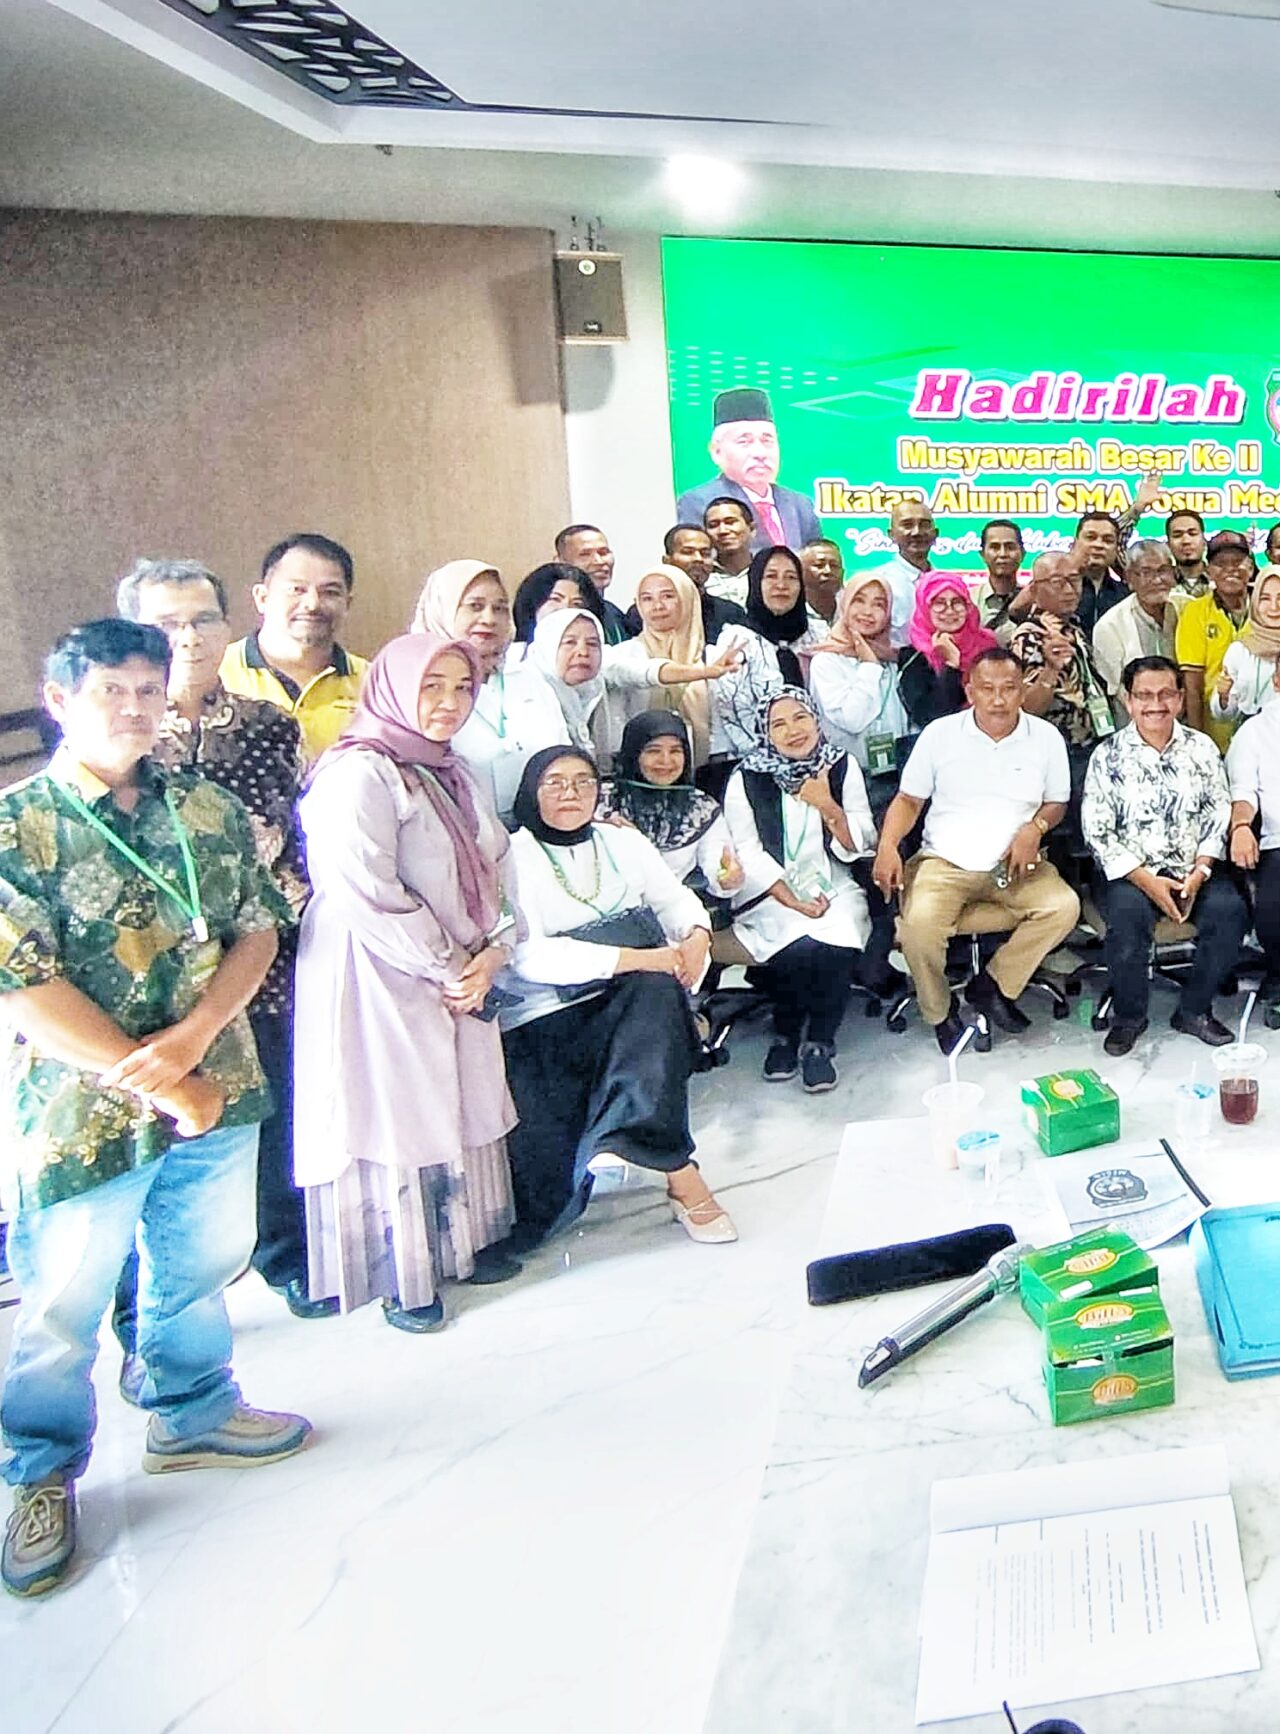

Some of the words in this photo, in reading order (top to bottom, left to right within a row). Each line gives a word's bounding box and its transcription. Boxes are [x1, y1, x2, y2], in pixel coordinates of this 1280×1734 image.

[914, 372, 1243, 420] Hadirilah
[901, 440, 1091, 476] Musyawarah
[1100, 441, 1186, 471] Besar
[1191, 443, 1232, 471] Ke
[931, 482, 1049, 513] Alumni
[1056, 483, 1131, 513] SMA
[1143, 484, 1222, 514] osua
